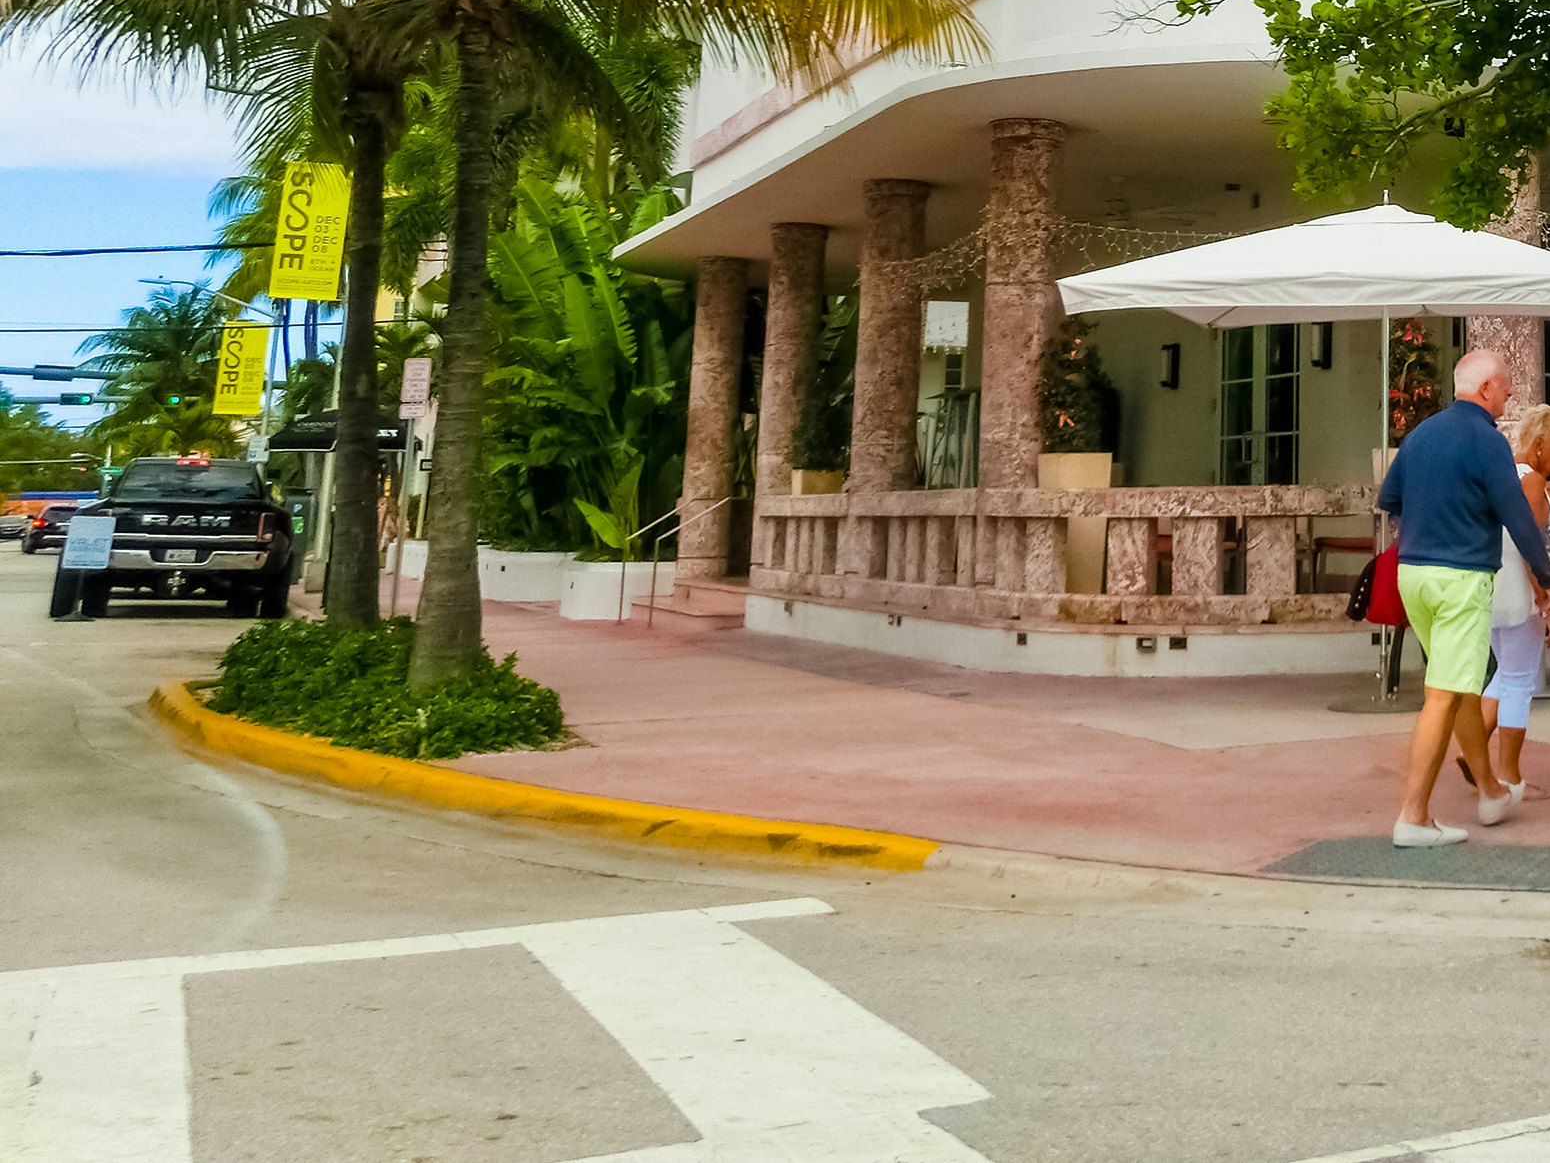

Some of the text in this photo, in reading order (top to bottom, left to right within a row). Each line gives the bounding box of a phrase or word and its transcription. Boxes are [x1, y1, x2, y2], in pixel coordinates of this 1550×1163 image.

[316, 215, 341, 225] DEC
[314, 224, 329, 234] 03
[314, 235, 338, 245] DEC
[312, 244, 327, 253] 08
[142, 514, 231, 528] RAM
